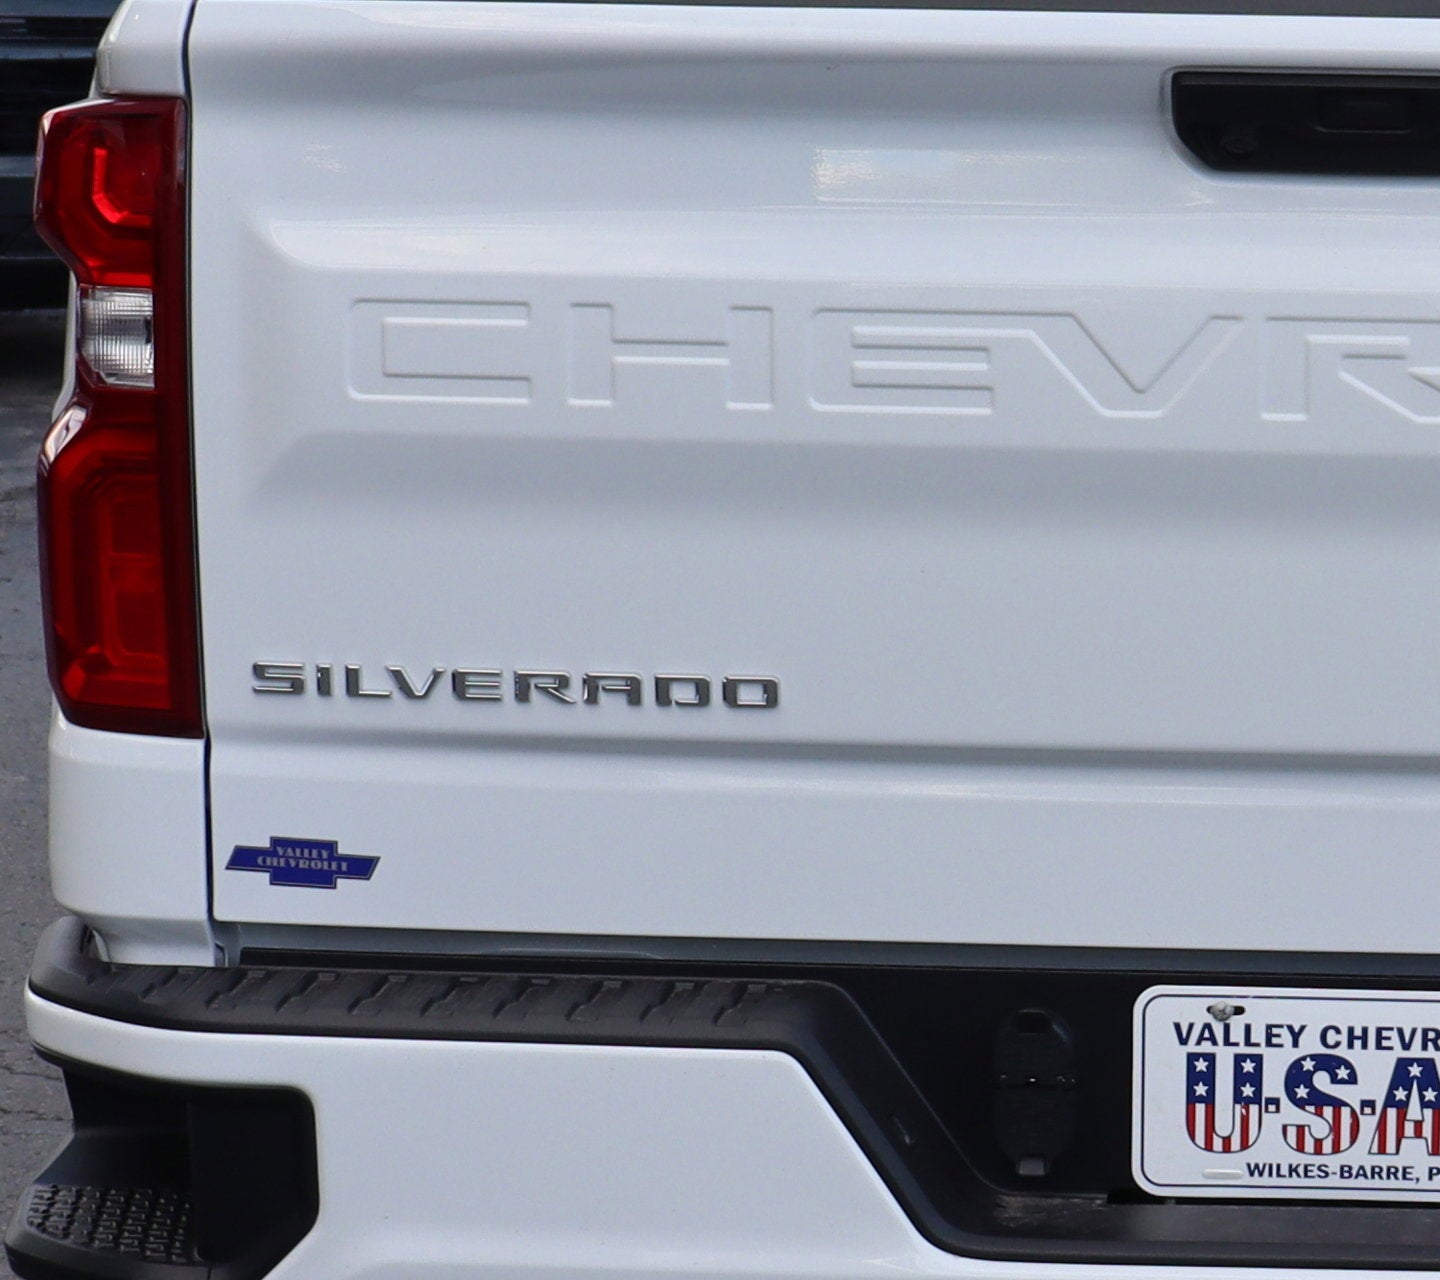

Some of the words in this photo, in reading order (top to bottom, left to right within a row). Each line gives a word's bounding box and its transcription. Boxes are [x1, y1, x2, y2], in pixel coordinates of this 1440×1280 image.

[251, 660, 781, 710] SILVERADO
[257, 855, 349, 873] CHEVROLET
[275, 846, 331, 860] VALLEY
[1173, 1021, 1307, 1049] VALLEY
[1246, 1162, 1421, 1184] WILKES-BARRE,
